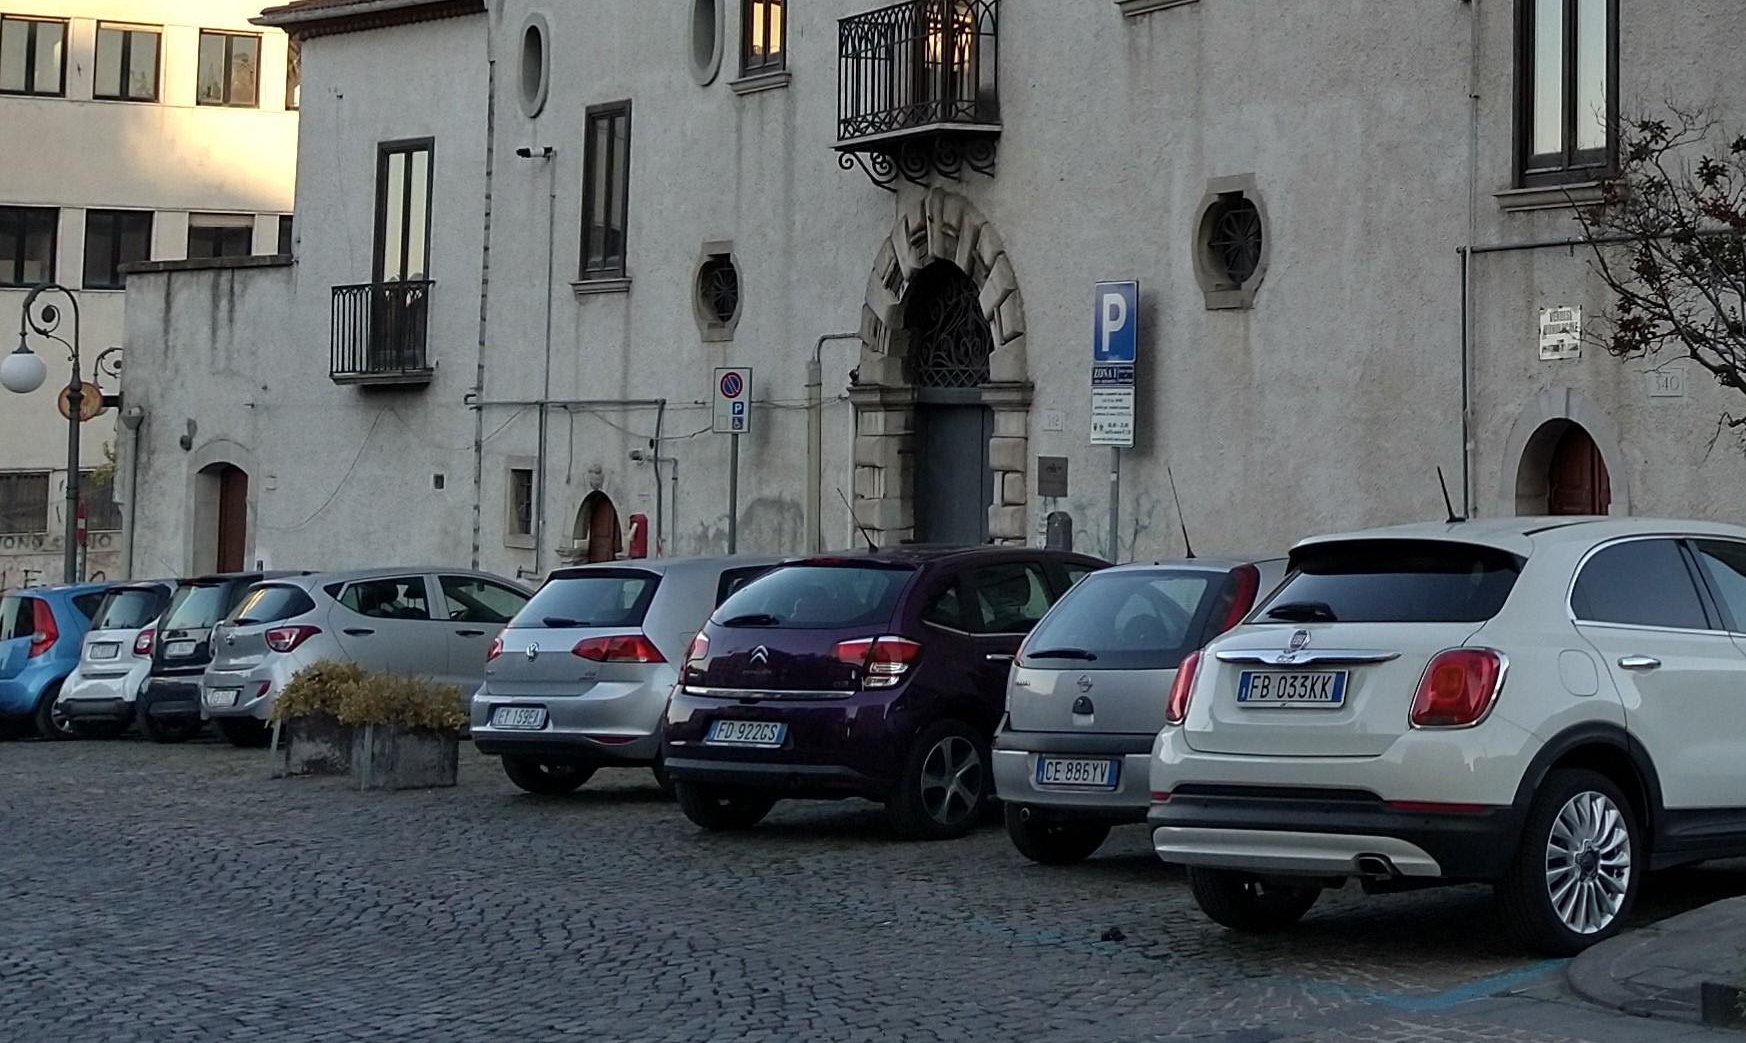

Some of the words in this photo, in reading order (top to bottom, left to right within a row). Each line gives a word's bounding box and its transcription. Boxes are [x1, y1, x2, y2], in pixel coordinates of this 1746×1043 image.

[1102, 293, 1127, 352] P
[734, 403, 742, 414] P
[1249, 675, 1271, 699] FB
[1276, 675, 1332, 699] 033KK
[716, 722, 734, 739] FD
[737, 723, 779, 741] 922GS
[1045, 761, 1062, 781] CE
[1066, 762, 1108, 782] 886YV
